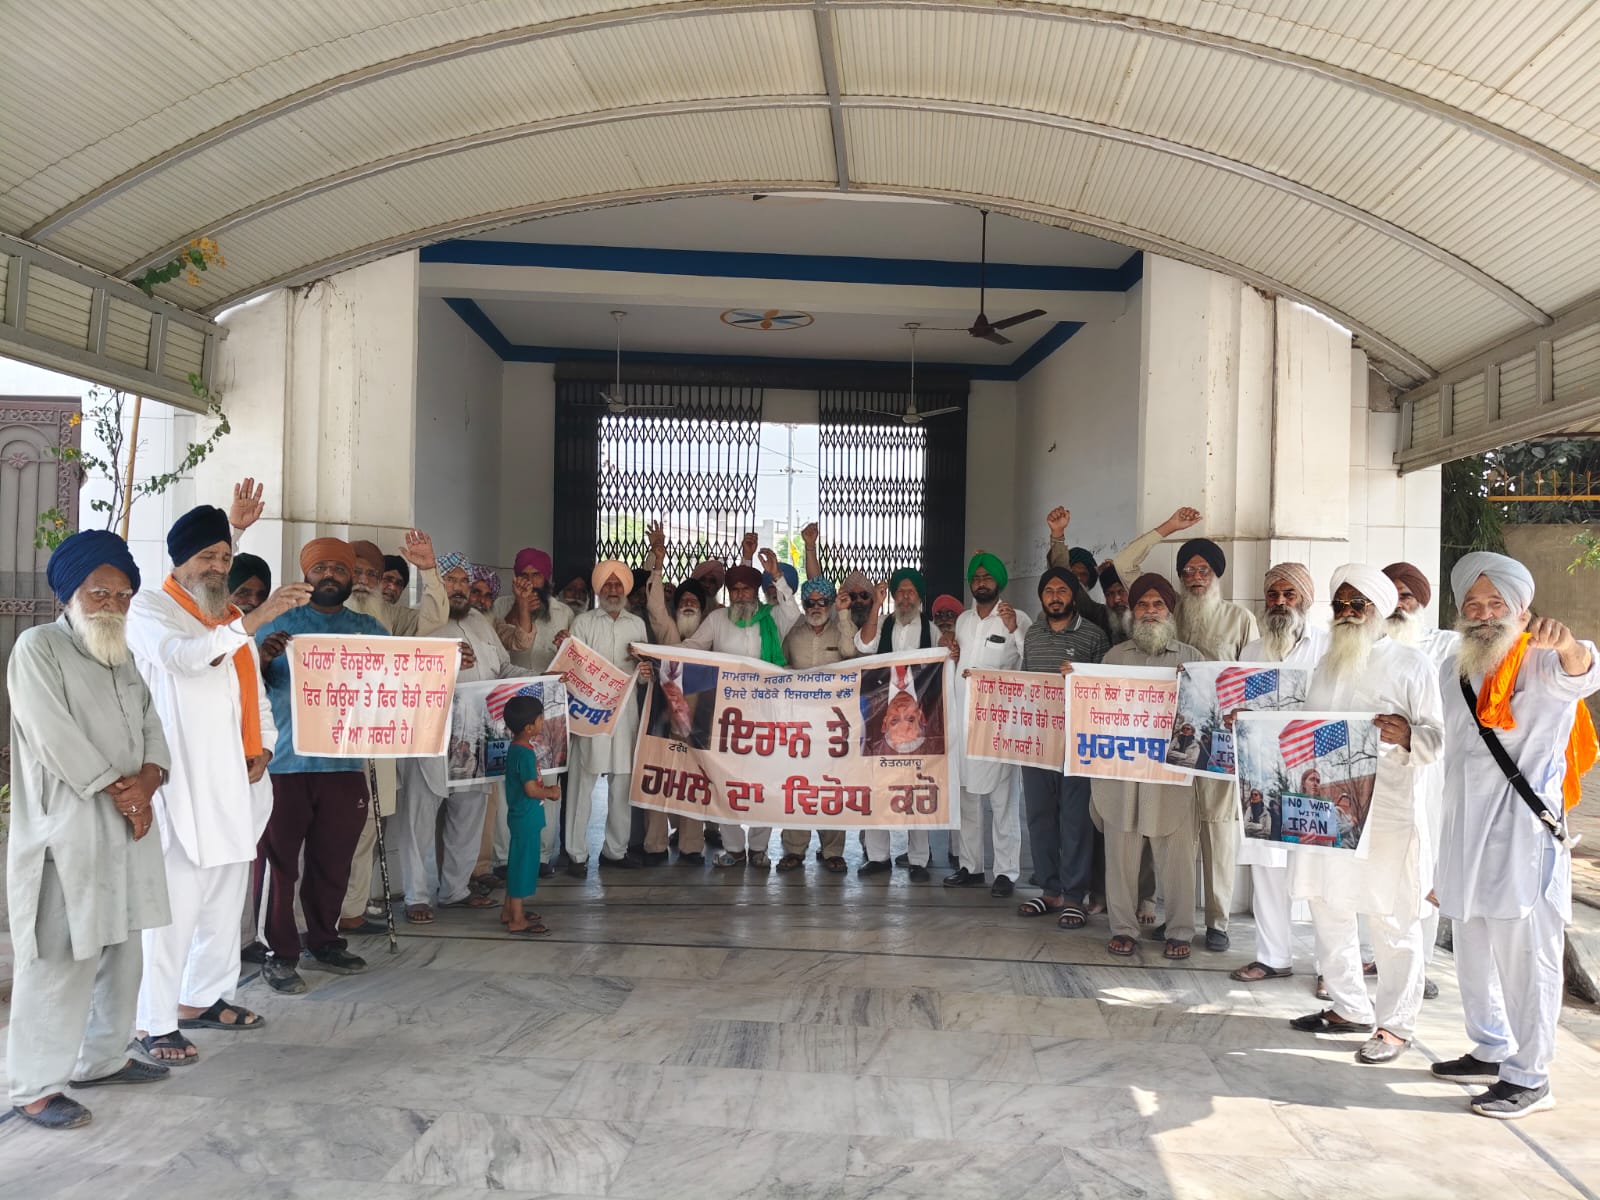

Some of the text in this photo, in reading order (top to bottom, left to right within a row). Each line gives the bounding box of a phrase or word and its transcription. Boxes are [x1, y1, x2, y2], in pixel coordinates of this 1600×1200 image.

[302, 644, 336, 671] ਪਹਿਲਾਂ
[394, 653, 410, 676] ਹੁਣ
[797, 671, 836, 683] ਅਮਰੀਕਾ
[840, 671, 858, 683] ਅਤੇ
[303, 681, 321, 706] ਫਿਰ
[326, 682, 360, 716] ਕਿਊਬਾ
[363, 682, 374, 708] ਤੇ
[377, 682, 398, 708] ਫਿਰ
[425, 684, 447, 709] ਵਾਰੀ
[1074, 681, 1101, 700] ਇਰਾਨੀ
[1125, 689, 1135, 702] ਦਾ
[1138, 685, 1165, 703] ਕਾਤਿਲ
[1012, 705, 1018, 725] ਤੇ
[1153, 711, 1174, 730] ਗੱਠਜੋ
[332, 719, 344, 745] ਵੀ
[348, 726, 362, 745] ਆ
[367, 719, 396, 745] ਸਕਦੀ
[718, 706, 853, 758] ਇਰਾਨ ਤੇ
[1217, 733, 1231, 743] NO
[1002, 738, 1012, 752] ਆ
[1015, 736, 1032, 755] ਸਕਦੀ
[1077, 733, 1170, 765] ਮੁਰਦਾਬ
[1216, 750, 1235, 765] IR
[641, 763, 940, 816] ਹਮਲੇ ਦਾ ਵਿਰੋਧ ਕਰੋ
[1288, 797, 1332, 813] NO WAR
[1298, 809, 1319, 818] WITH
[1287, 817, 1328, 834] IRAN
